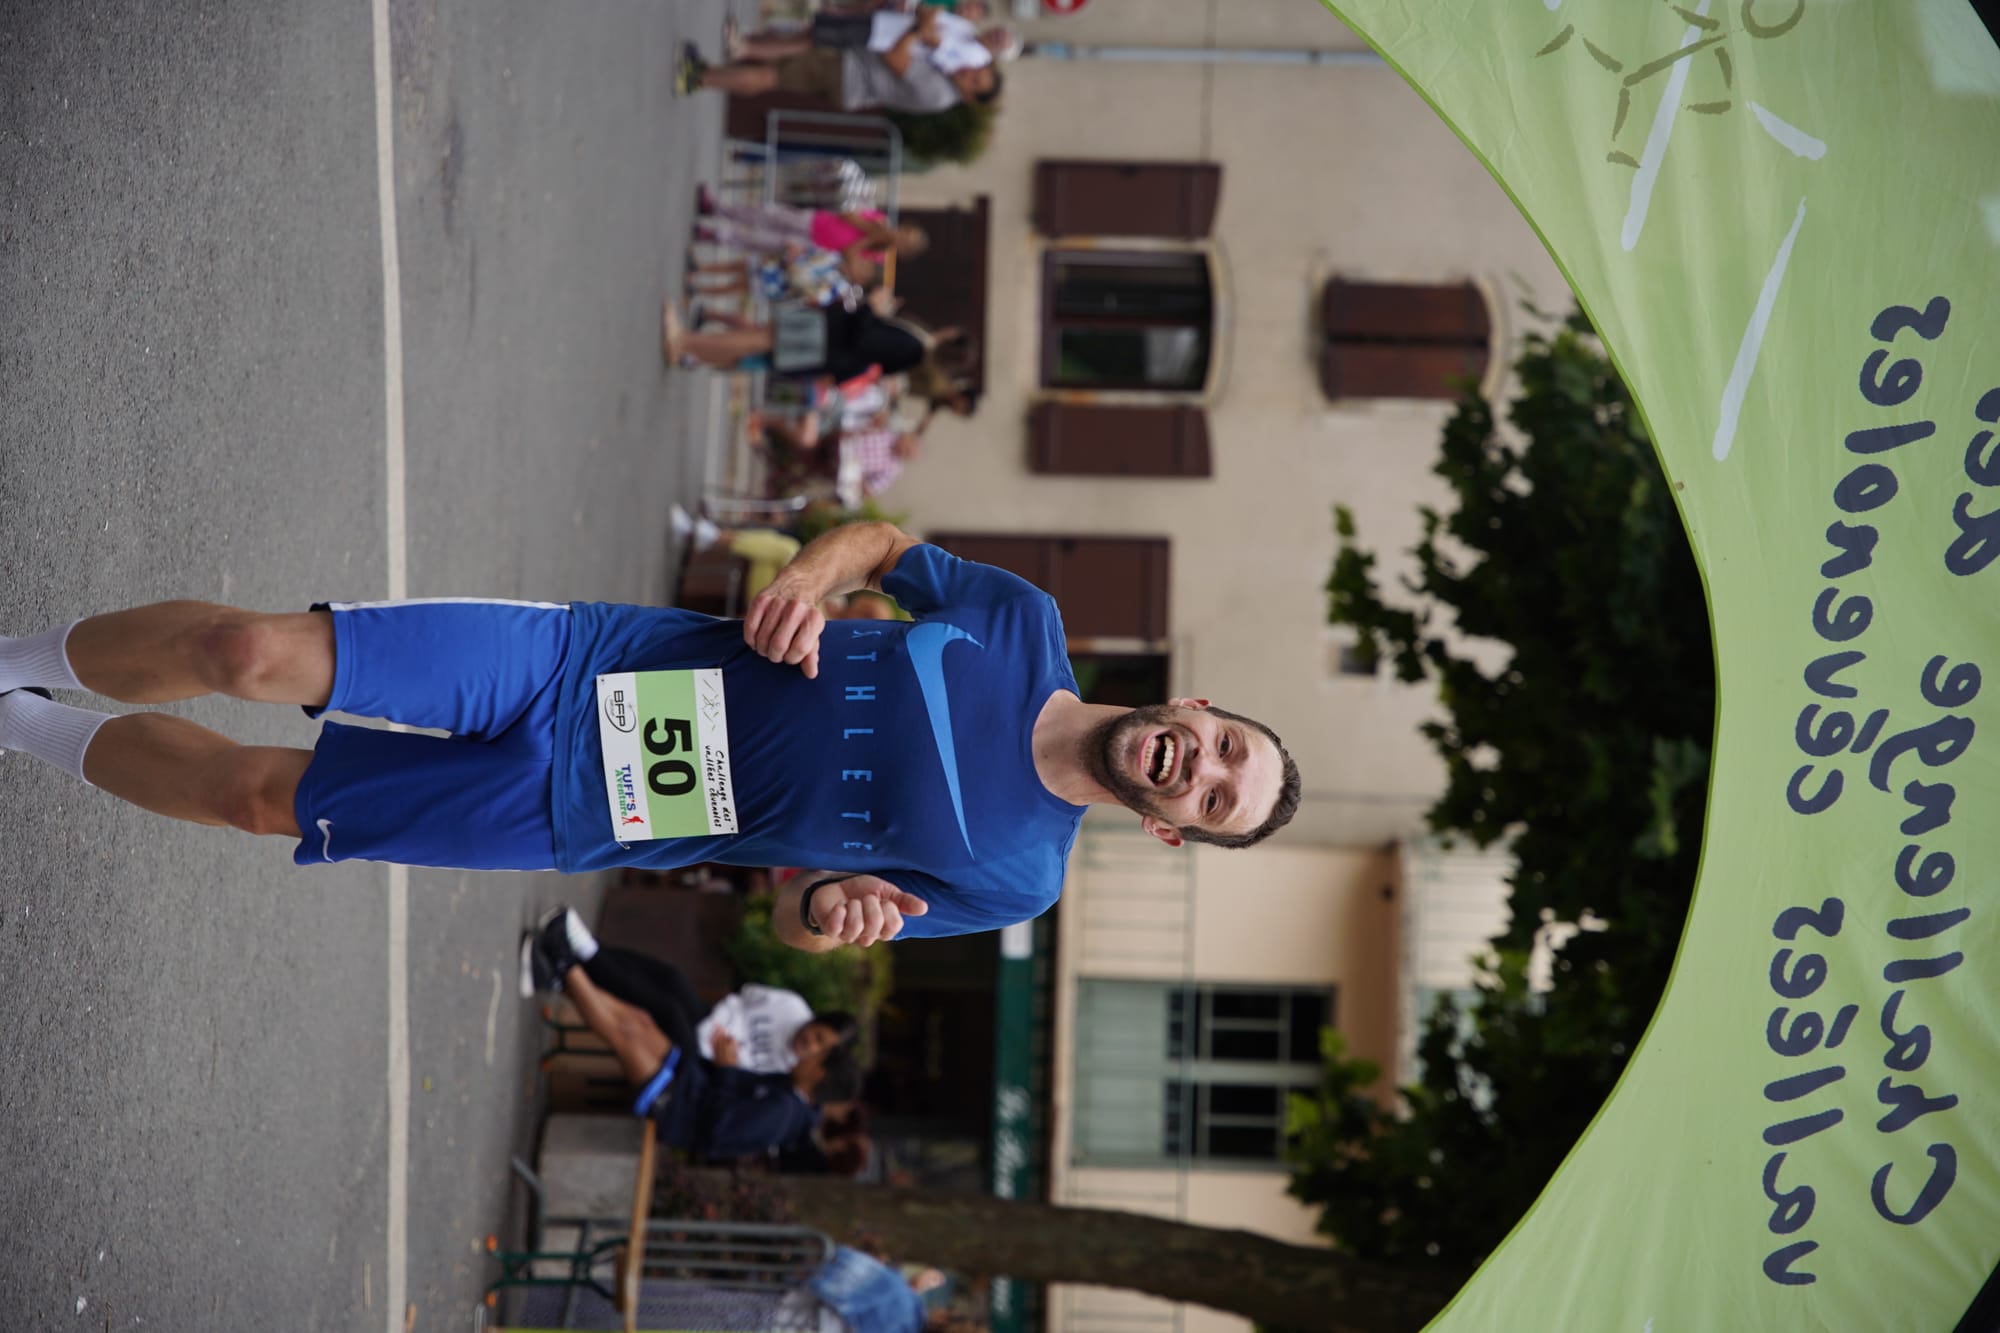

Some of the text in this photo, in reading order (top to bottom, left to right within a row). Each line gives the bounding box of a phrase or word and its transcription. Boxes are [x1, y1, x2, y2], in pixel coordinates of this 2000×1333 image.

[614, 691, 625, 727] BFP
[643, 718, 696, 796] 50
[705, 745, 721, 827] vallées cévenoles
[716, 751, 731, 822] Challenge des
[615, 769, 628, 816] Aventure
[621, 764, 636, 811] TUFF'S
